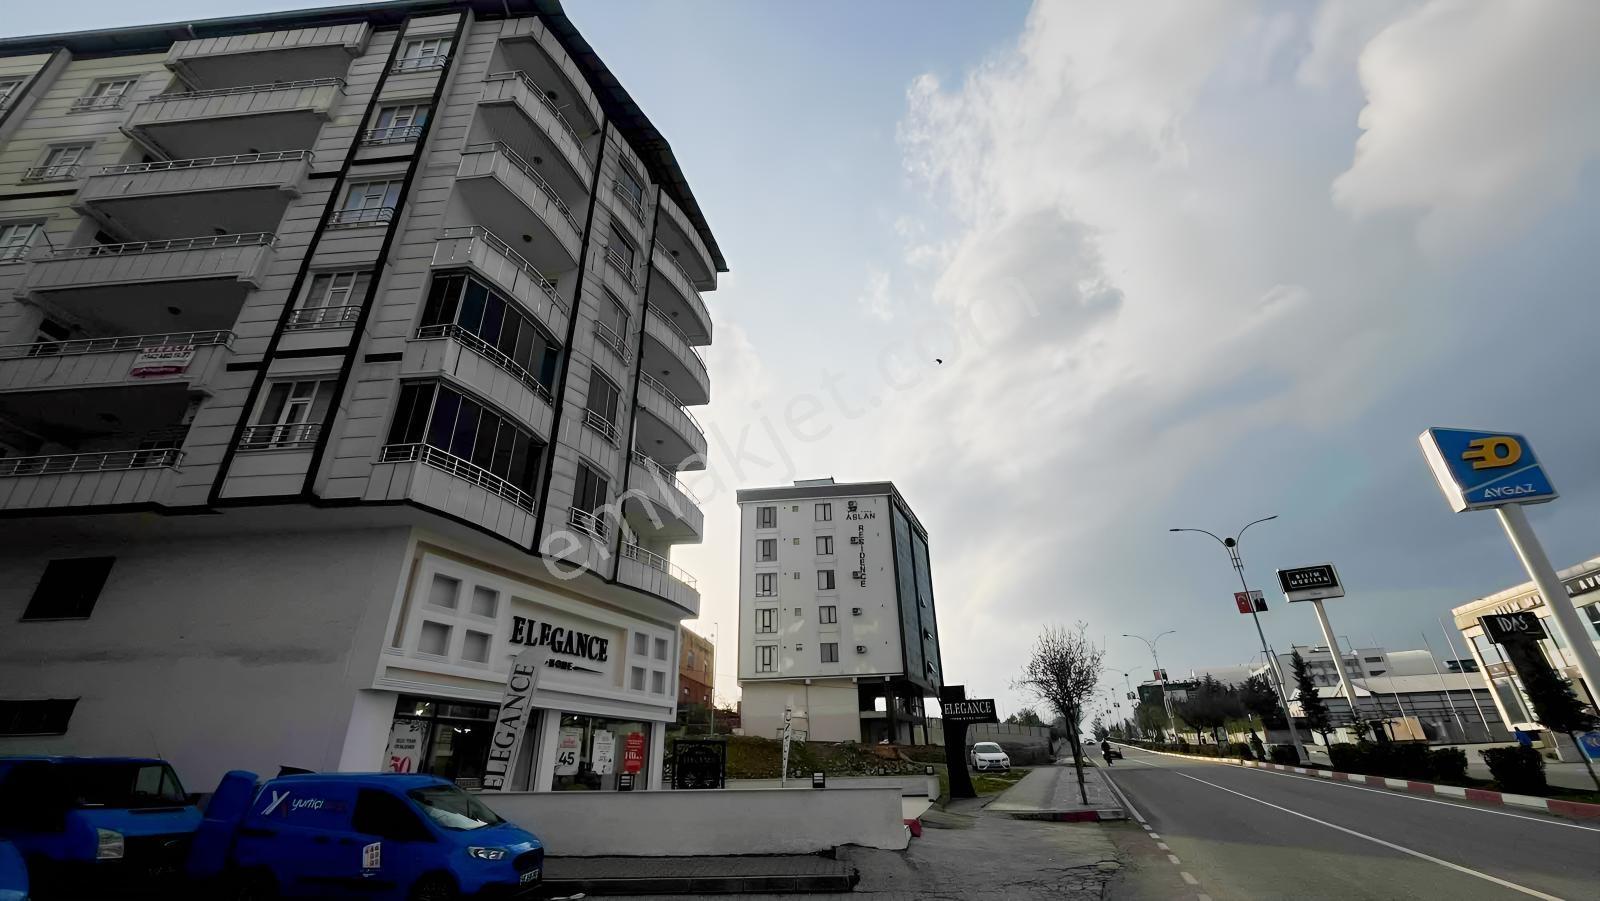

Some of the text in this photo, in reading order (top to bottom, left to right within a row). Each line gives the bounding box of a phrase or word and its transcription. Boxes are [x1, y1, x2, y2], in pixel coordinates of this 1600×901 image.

[1484, 483, 1537, 498] AYGAZ
[509, 615, 609, 662] ELEGANCE
[944, 701, 992, 715] ELEGANCE
[483, 663, 535, 791] ELEGANCE
[558, 751, 575, 766] 45
